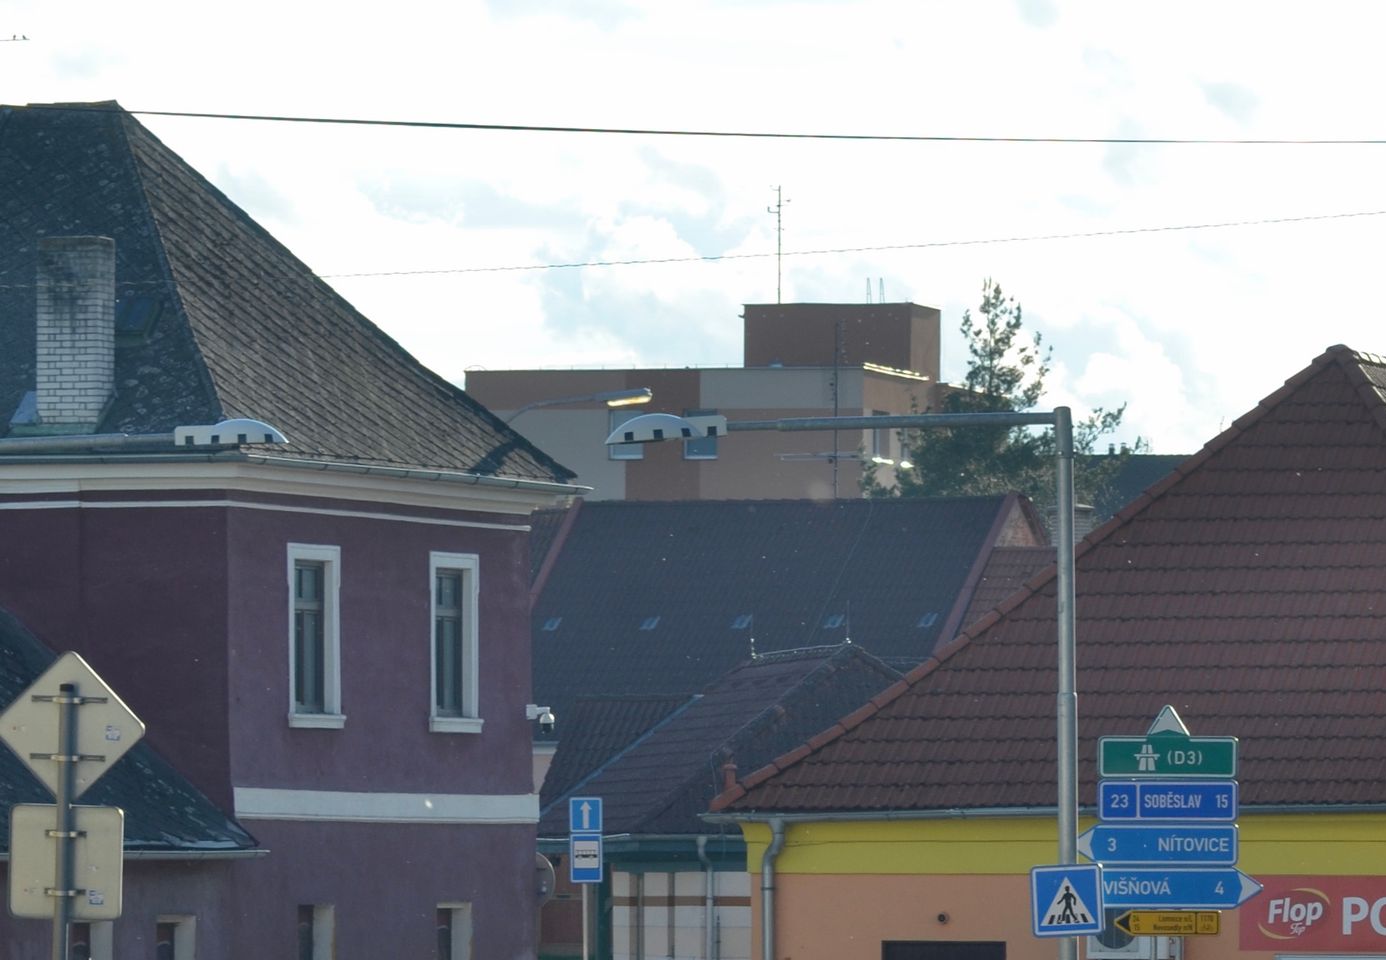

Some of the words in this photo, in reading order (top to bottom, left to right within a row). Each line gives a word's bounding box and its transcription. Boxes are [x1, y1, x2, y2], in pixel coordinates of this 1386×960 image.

[1167, 750, 1202, 766] (D3)
[1110, 794, 1129, 808] 23
[1144, 791, 1202, 808] SOBĚSLAV
[1215, 794, 1229, 808] 15
[1107, 837, 1117, 852] 3
[1158, 834, 1229, 852] NÍTOVICE
[1103, 877, 1172, 896] VIŠŇOVÁ
[1214, 881, 1225, 896] 4
[1267, 897, 1324, 926] Flop
